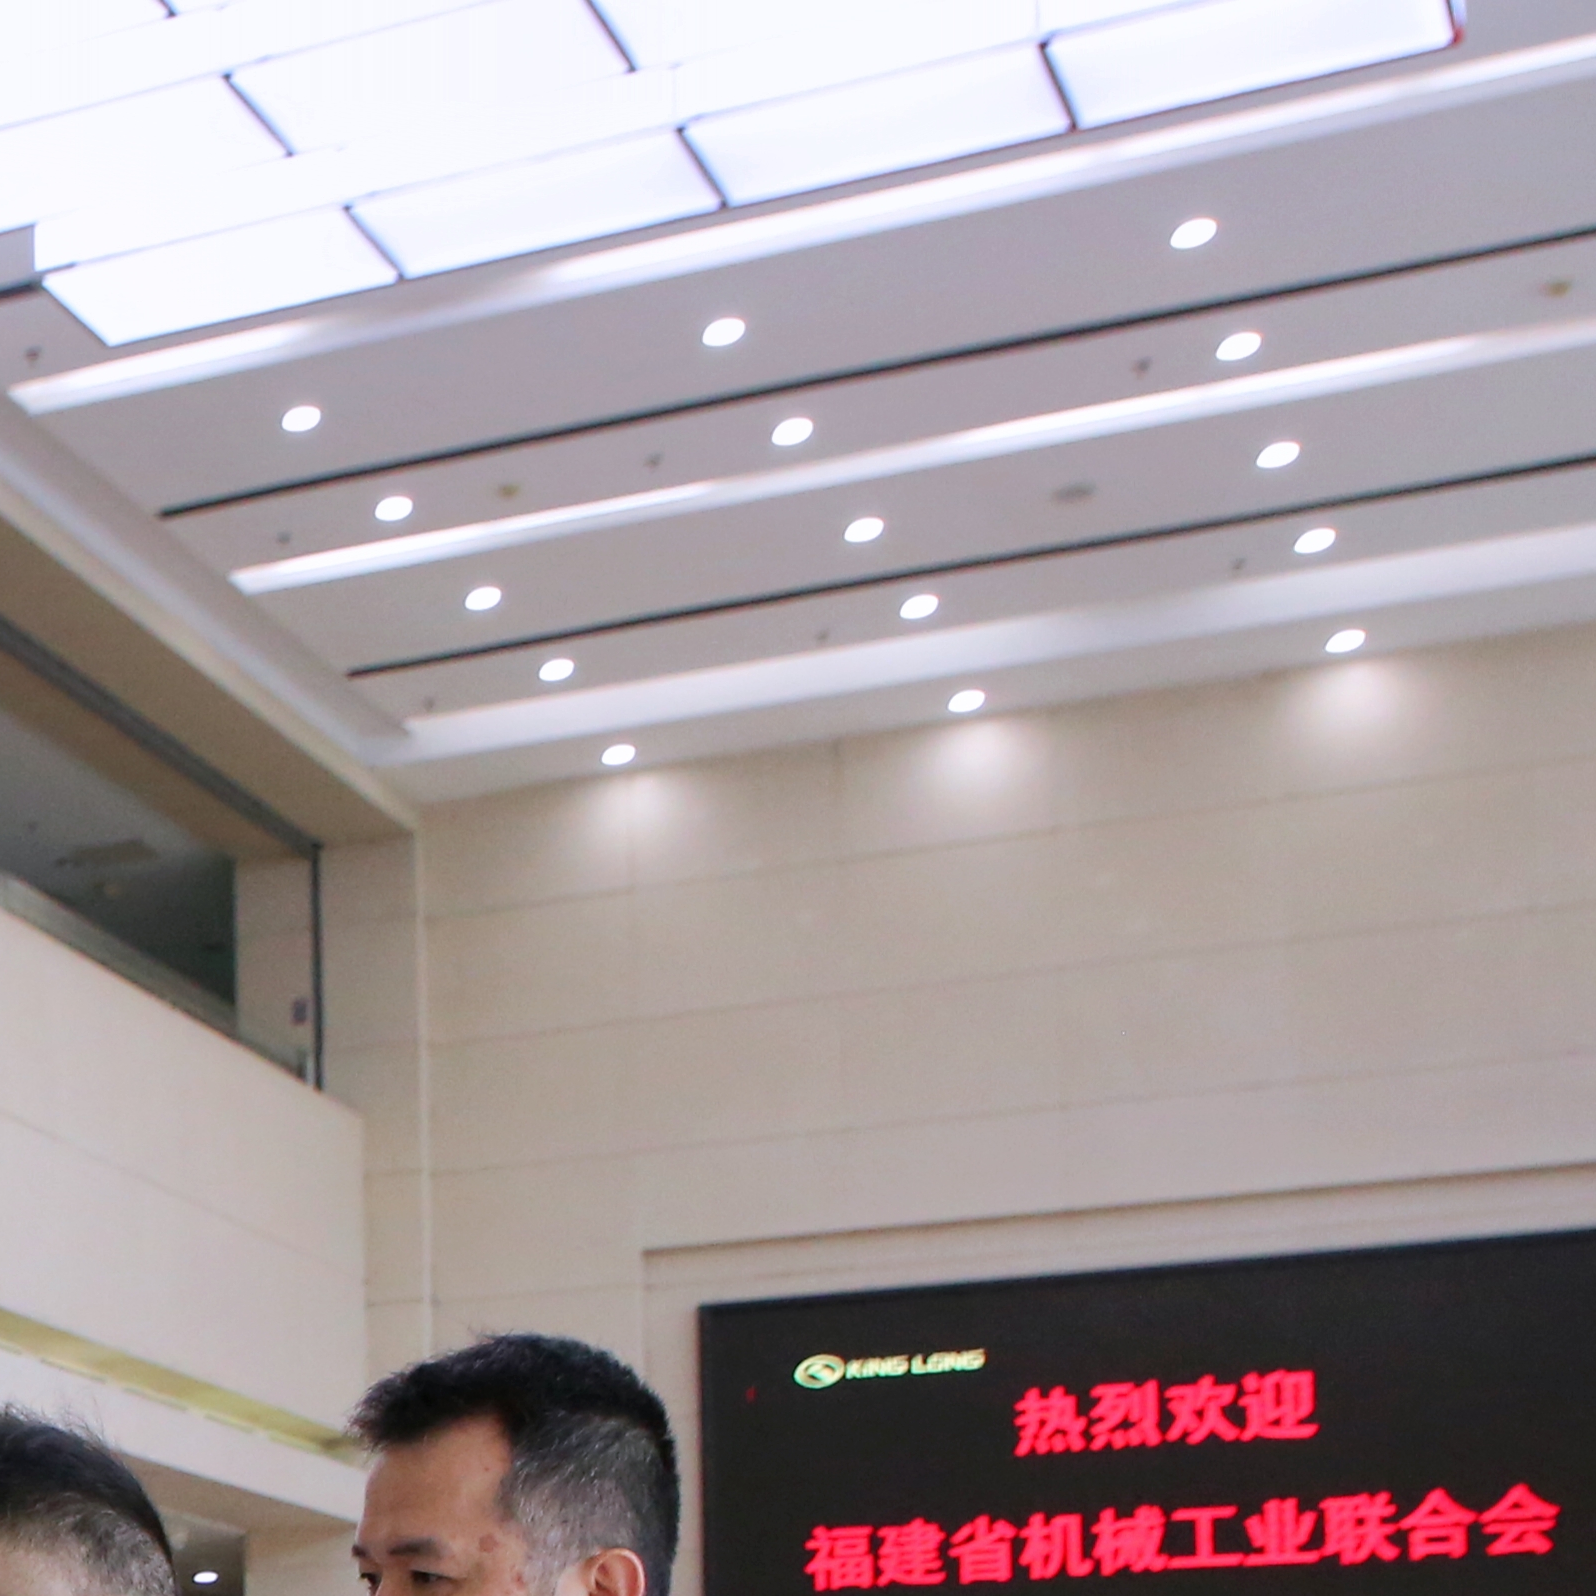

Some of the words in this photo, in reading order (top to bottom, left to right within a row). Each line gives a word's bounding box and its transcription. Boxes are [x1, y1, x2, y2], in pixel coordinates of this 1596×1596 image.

[844, 1355, 910, 1380] KING
[910, 1348, 987, 1375] LONG
[1012, 1368, 1321, 1458] 热烈欢迎
[804, 1482, 1561, 1592] 福建省机械工业联合会
